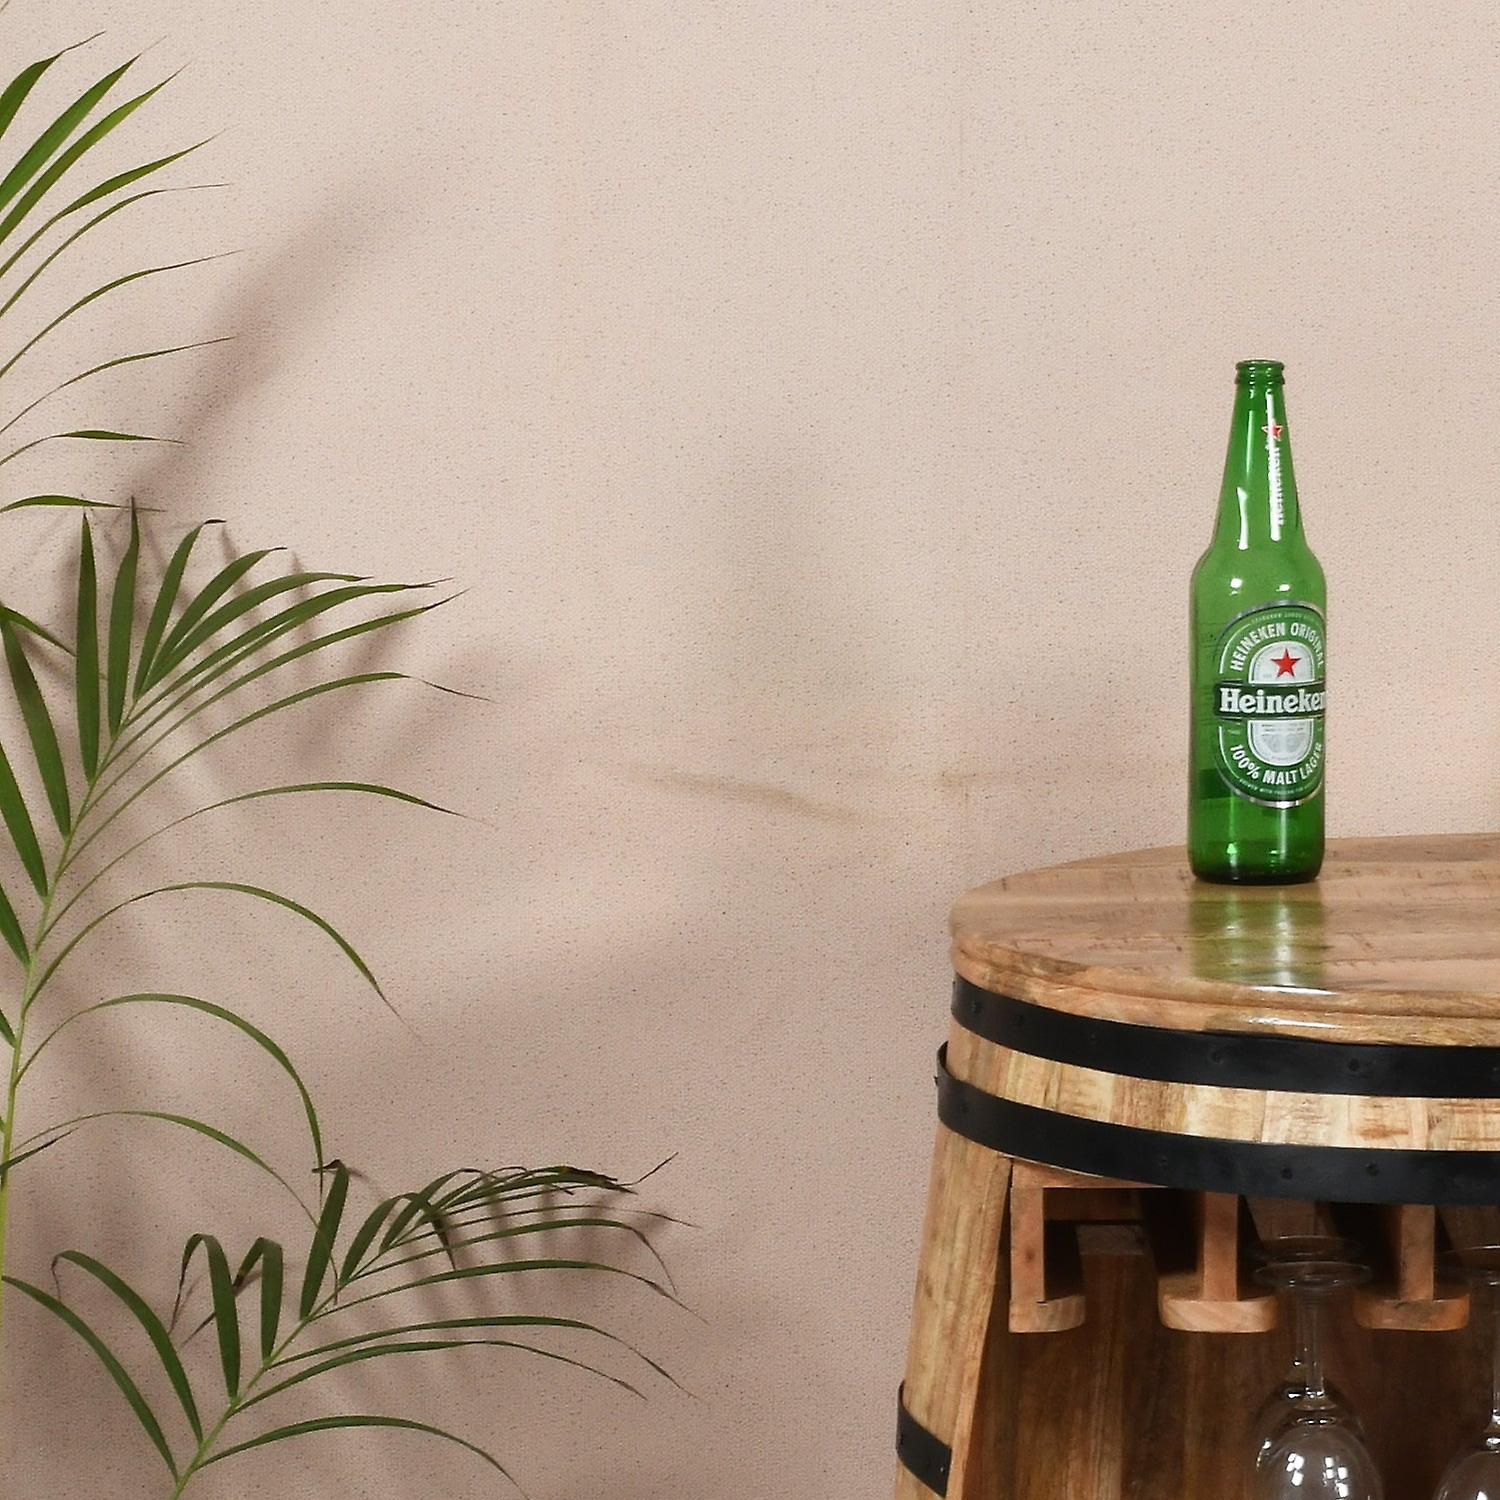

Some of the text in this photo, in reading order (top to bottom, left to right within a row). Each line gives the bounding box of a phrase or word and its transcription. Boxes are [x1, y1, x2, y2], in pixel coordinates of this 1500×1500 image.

[1230, 622, 1324, 671] HEINEKEN ORIGINAL
[1230, 742, 1322, 785] 100% MALT LAGER
